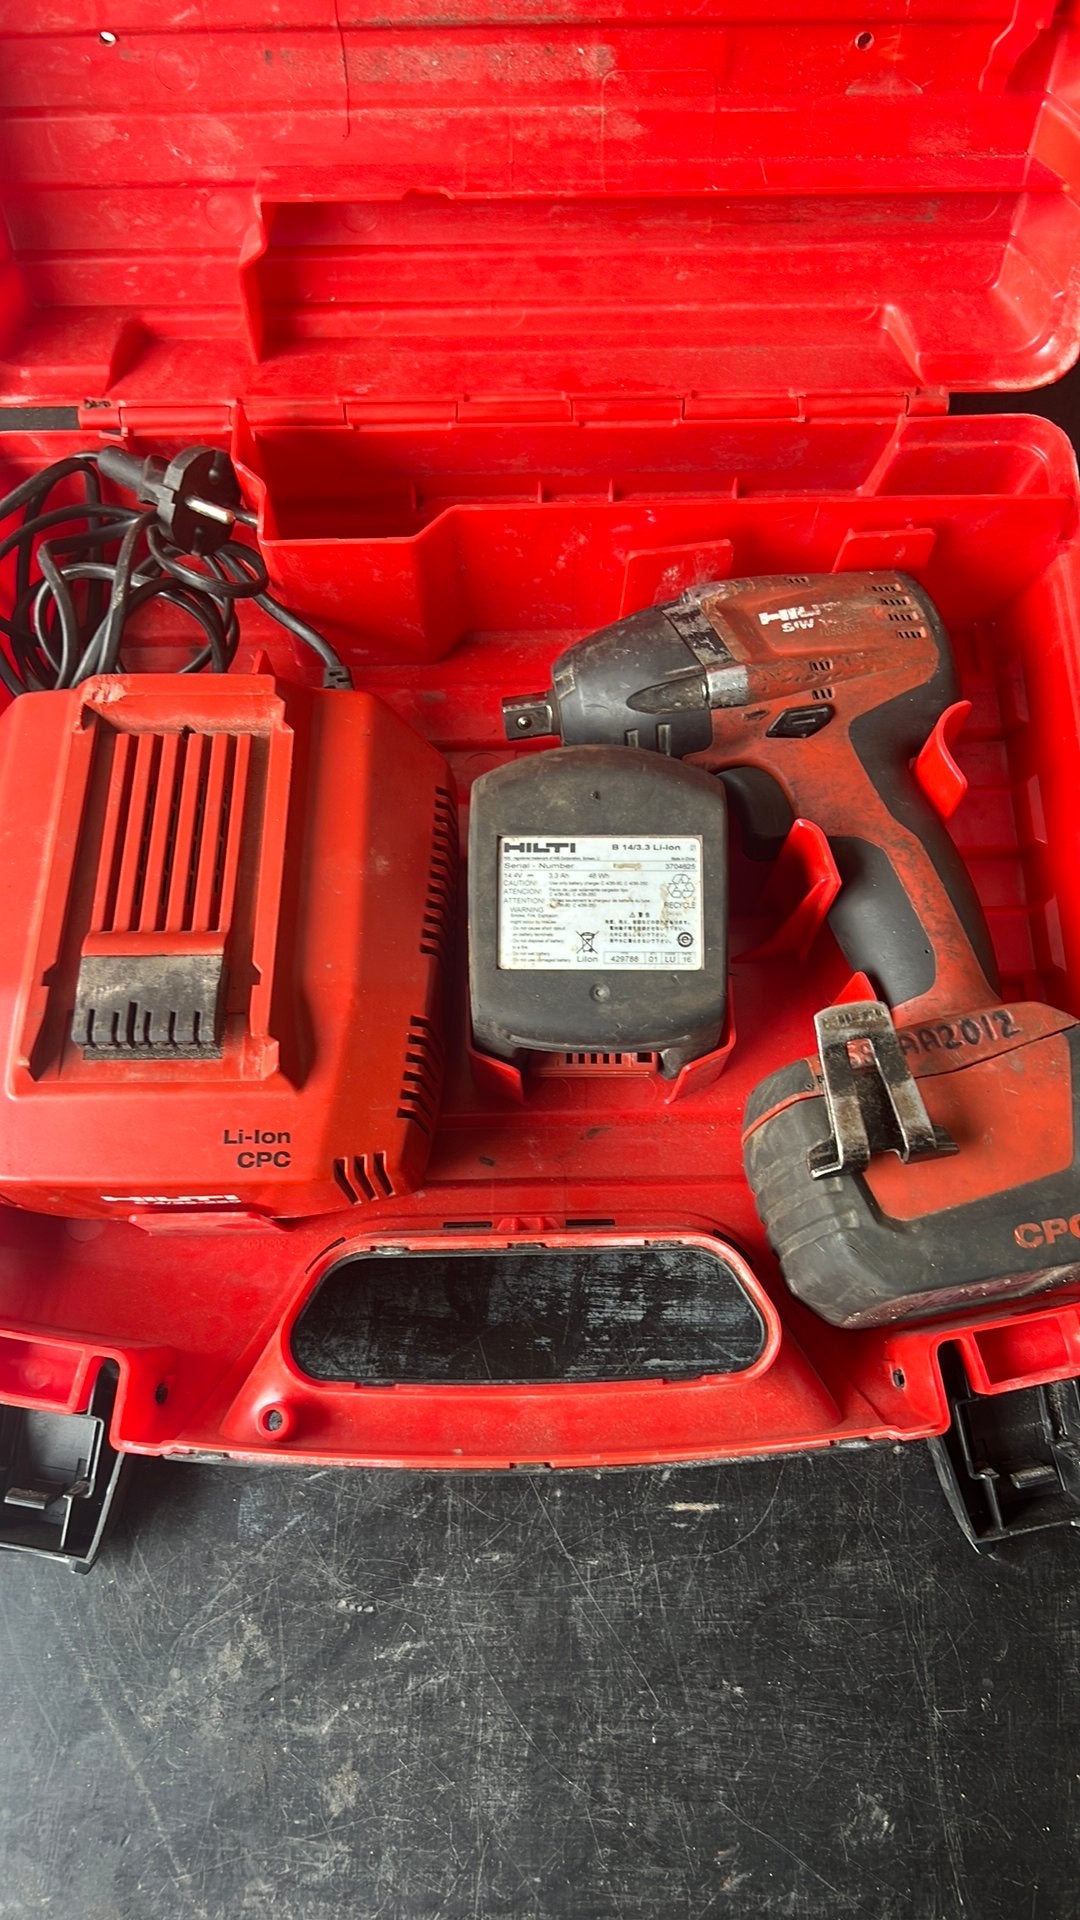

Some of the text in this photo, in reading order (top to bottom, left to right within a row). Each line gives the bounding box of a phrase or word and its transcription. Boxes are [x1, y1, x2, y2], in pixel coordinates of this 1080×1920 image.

[504, 843, 576, 853] HILTI
[224, 1129, 291, 1144] Li-Ion
[237, 1151, 291, 1168] CPC
[100, 1194, 239, 1202] HILTI
